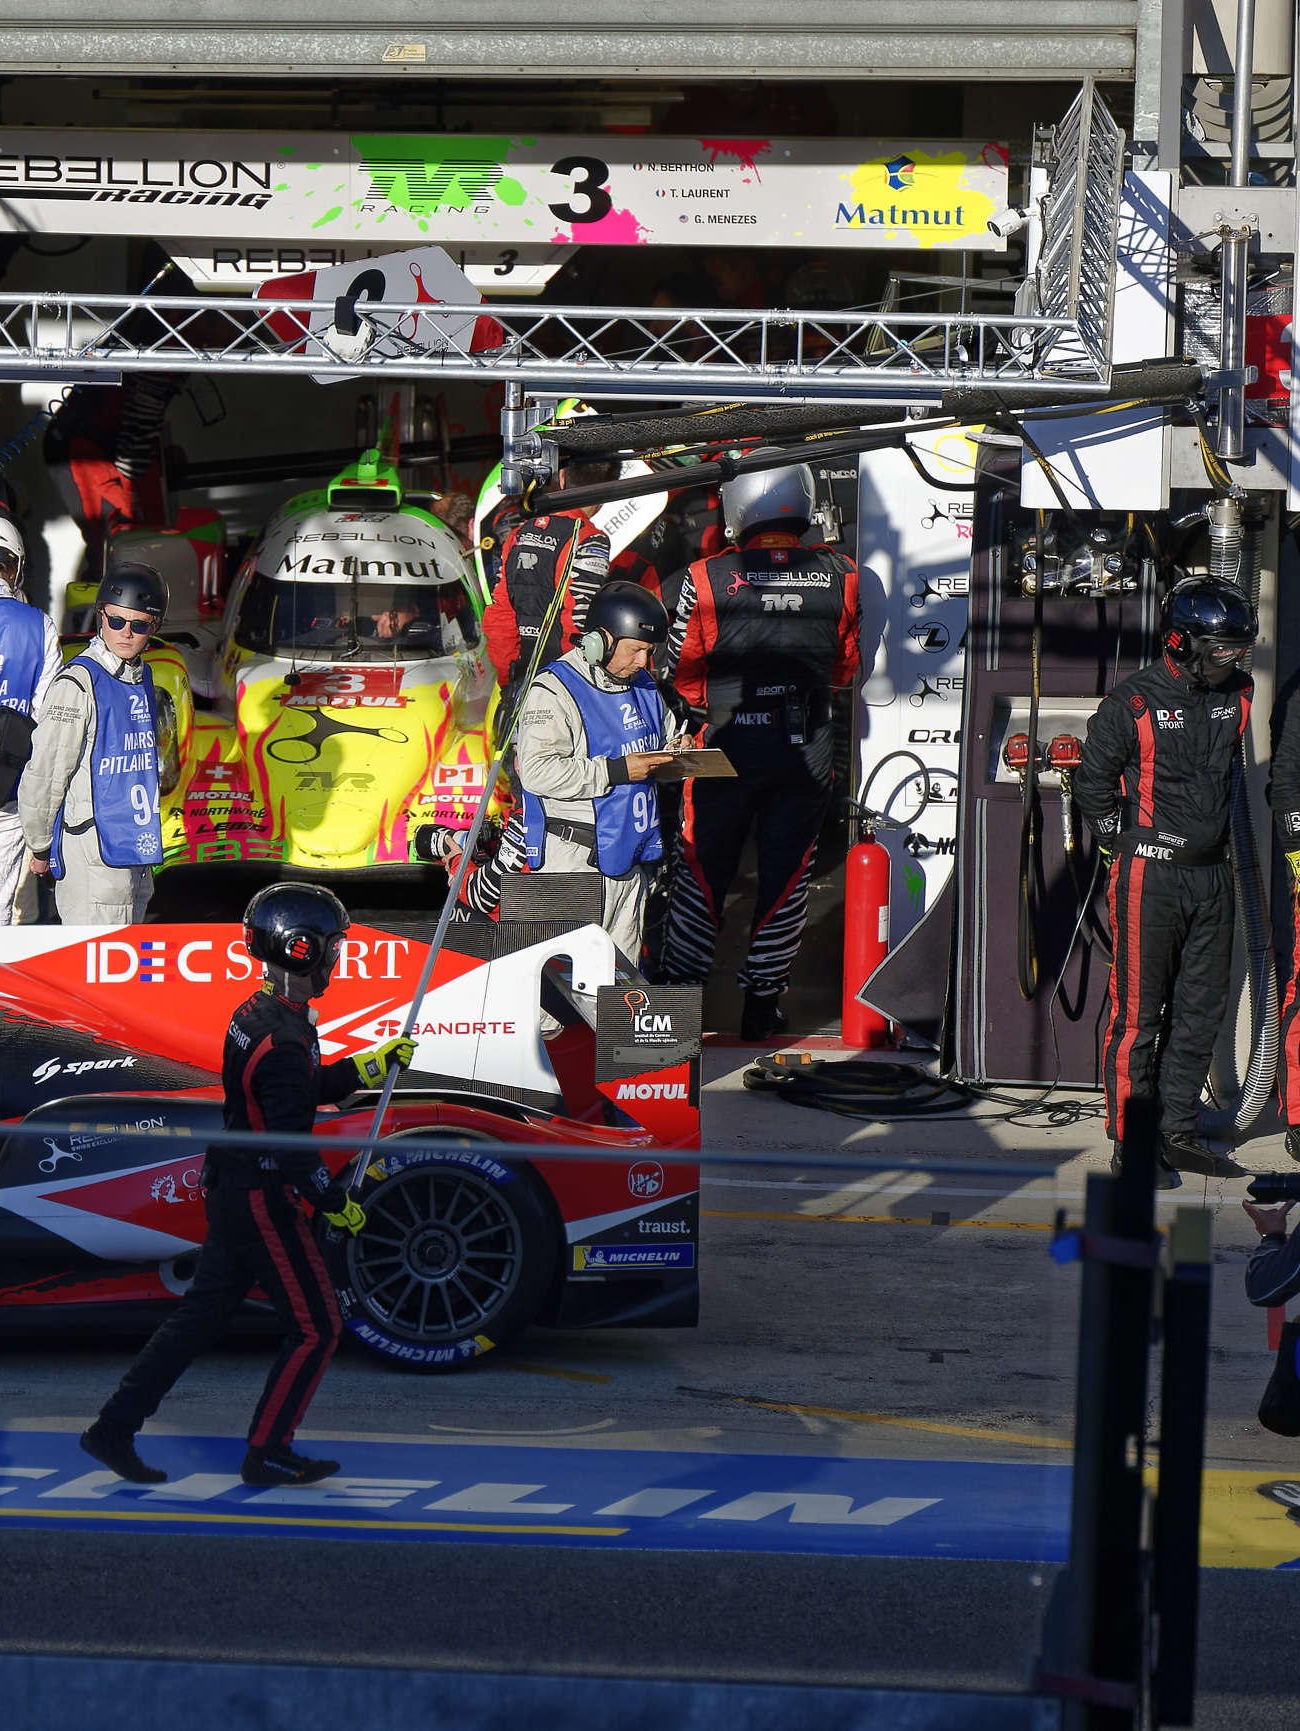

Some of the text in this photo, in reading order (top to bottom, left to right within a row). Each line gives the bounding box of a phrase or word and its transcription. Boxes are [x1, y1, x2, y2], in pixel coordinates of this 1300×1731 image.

[648, 162, 715, 173] N. BERTHON
[548, 156, 613, 224] 3
[670, 189, 731, 199] T. LAURENT
[359, 204, 491, 214] RACING
[835, 202, 965, 226] Matmut
[694, 214, 757, 225] G. MENEZES
[494, 249, 518, 276] 3
[284, 531, 436, 549] REBELLION
[275, 554, 444, 579] Matmut
[323, 673, 366, 693] 3
[734, 712, 772, 726] MRTC
[1158, 721, 1185, 730] SPORT
[438, 767, 474, 784] P1
[187, 791, 251, 801] MOTUL
[1135, 842, 1174, 860] MRTC
[86, 940, 409, 983] IDEC SRT
[635, 1015, 672, 1031] ICM
[62, 1054, 138, 1076] spark
[616, 1083, 688, 1100] MOTUL
[638, 1220, 690, 1234] traust.
[608, 1252, 680, 1262] MICHELIN
[355, 1323, 454, 1362] MICHELIN
